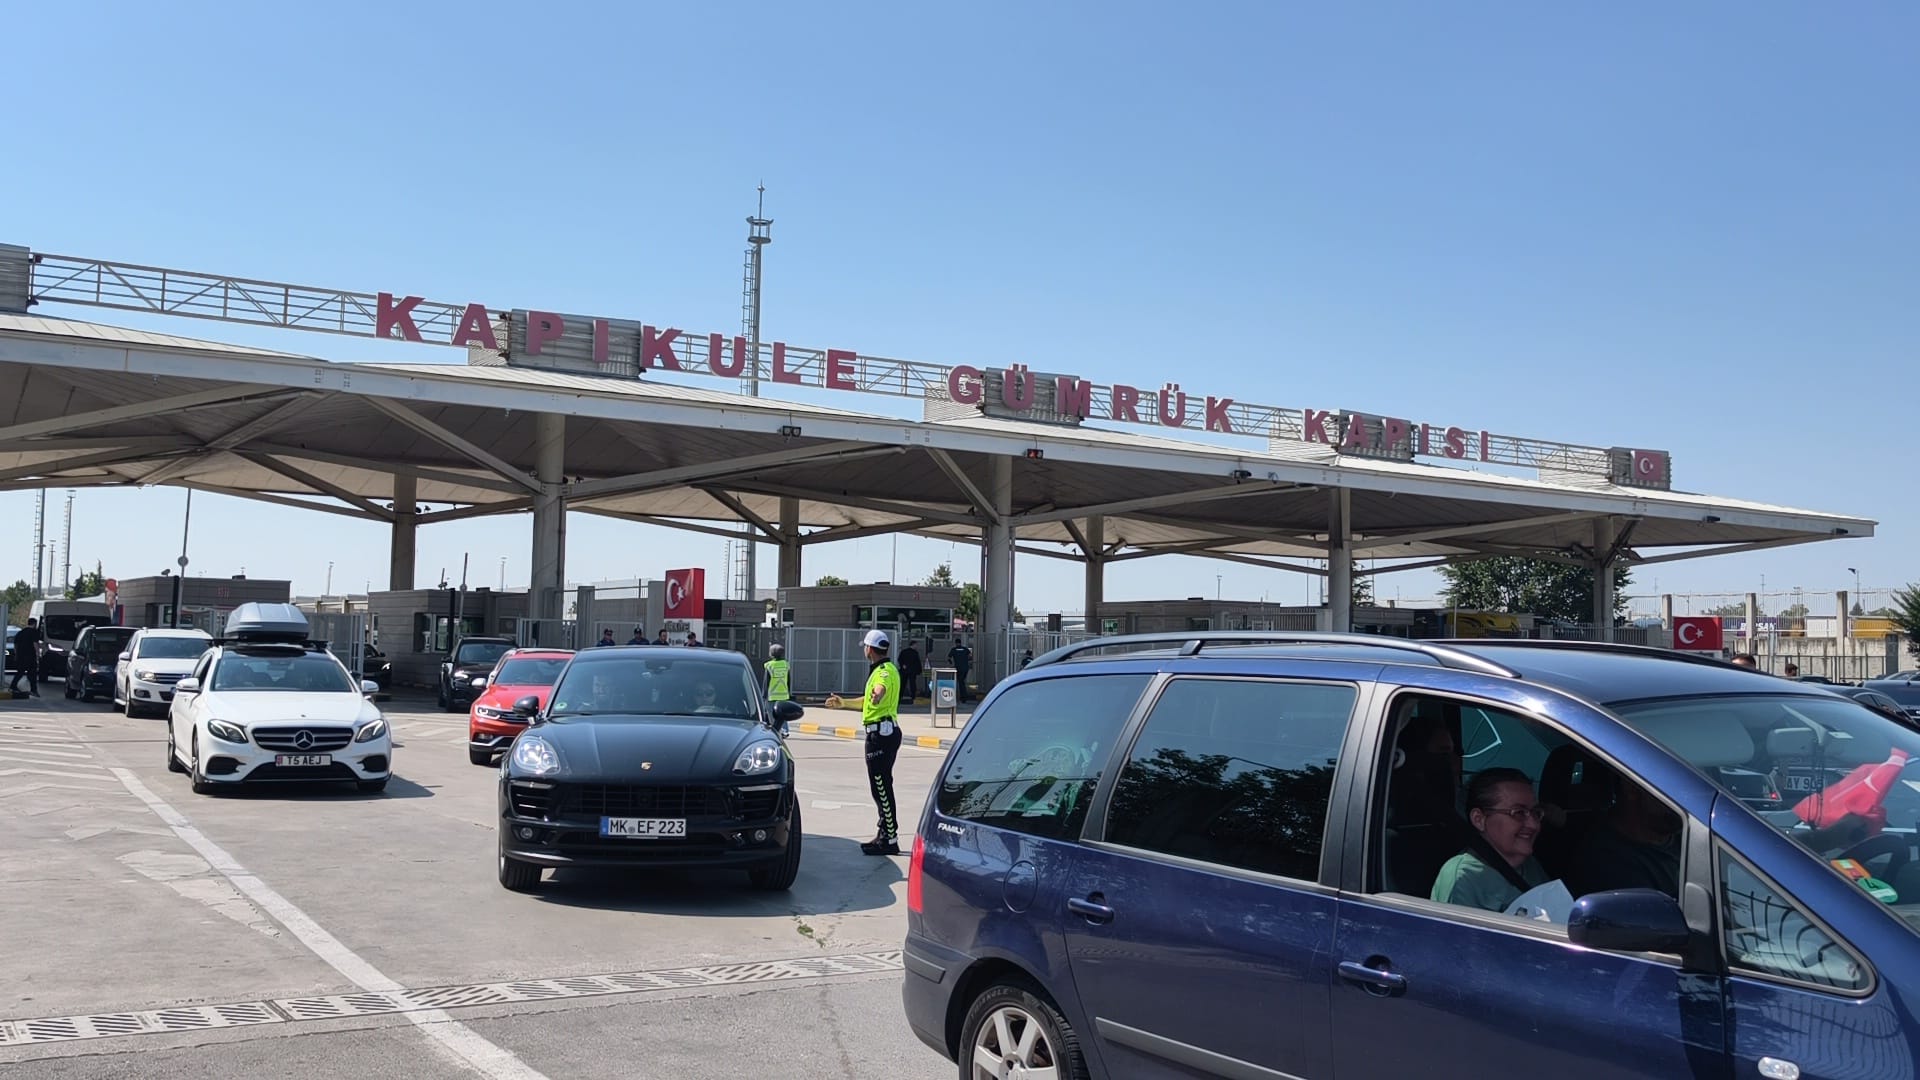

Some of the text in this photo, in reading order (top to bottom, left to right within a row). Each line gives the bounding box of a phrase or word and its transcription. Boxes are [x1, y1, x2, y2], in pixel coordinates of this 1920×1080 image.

[375, 292, 1491, 462] KAPIKULE GÜMRÜK KAPISI
[609, 820, 684, 834] MK EF 223
[938, 822, 966, 835] FAMILY
